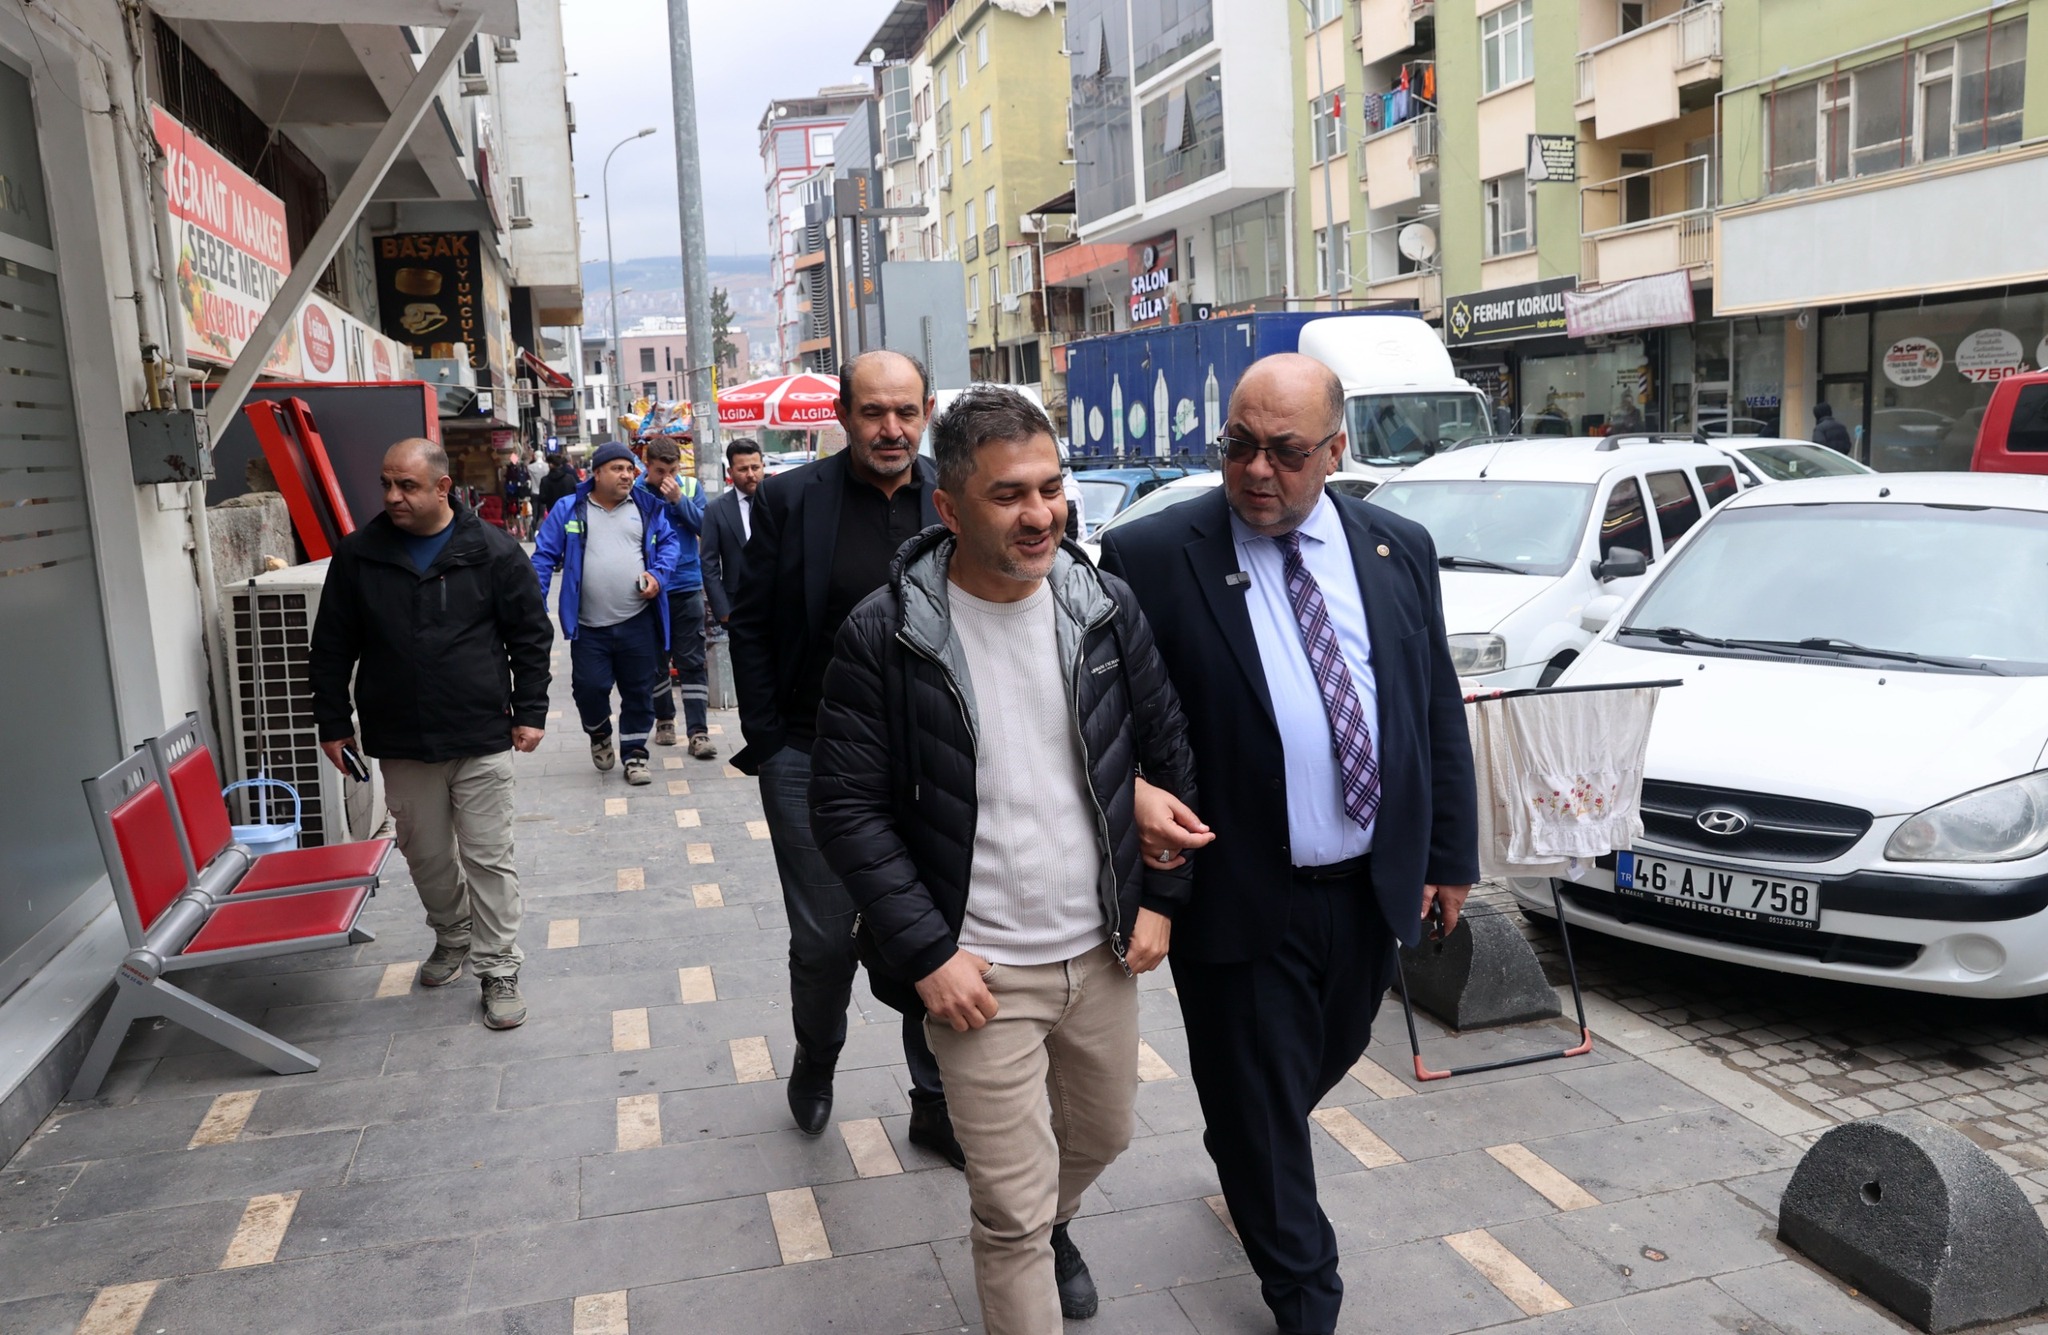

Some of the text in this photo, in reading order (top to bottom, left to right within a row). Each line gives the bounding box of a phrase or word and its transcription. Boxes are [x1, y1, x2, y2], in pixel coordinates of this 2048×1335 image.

[231, 189, 283, 265] MARKET
[187, 223, 237, 289] SEBZE
[382, 235, 470, 260] BAŞAK
[1131, 268, 1169, 296] SALON
[202, 290, 246, 343] KURU
[1473, 300, 1515, 323] FERHAT
[1620, 871, 1632, 882] TR
[1635, 858, 1809, 916] 46 AJV 758
